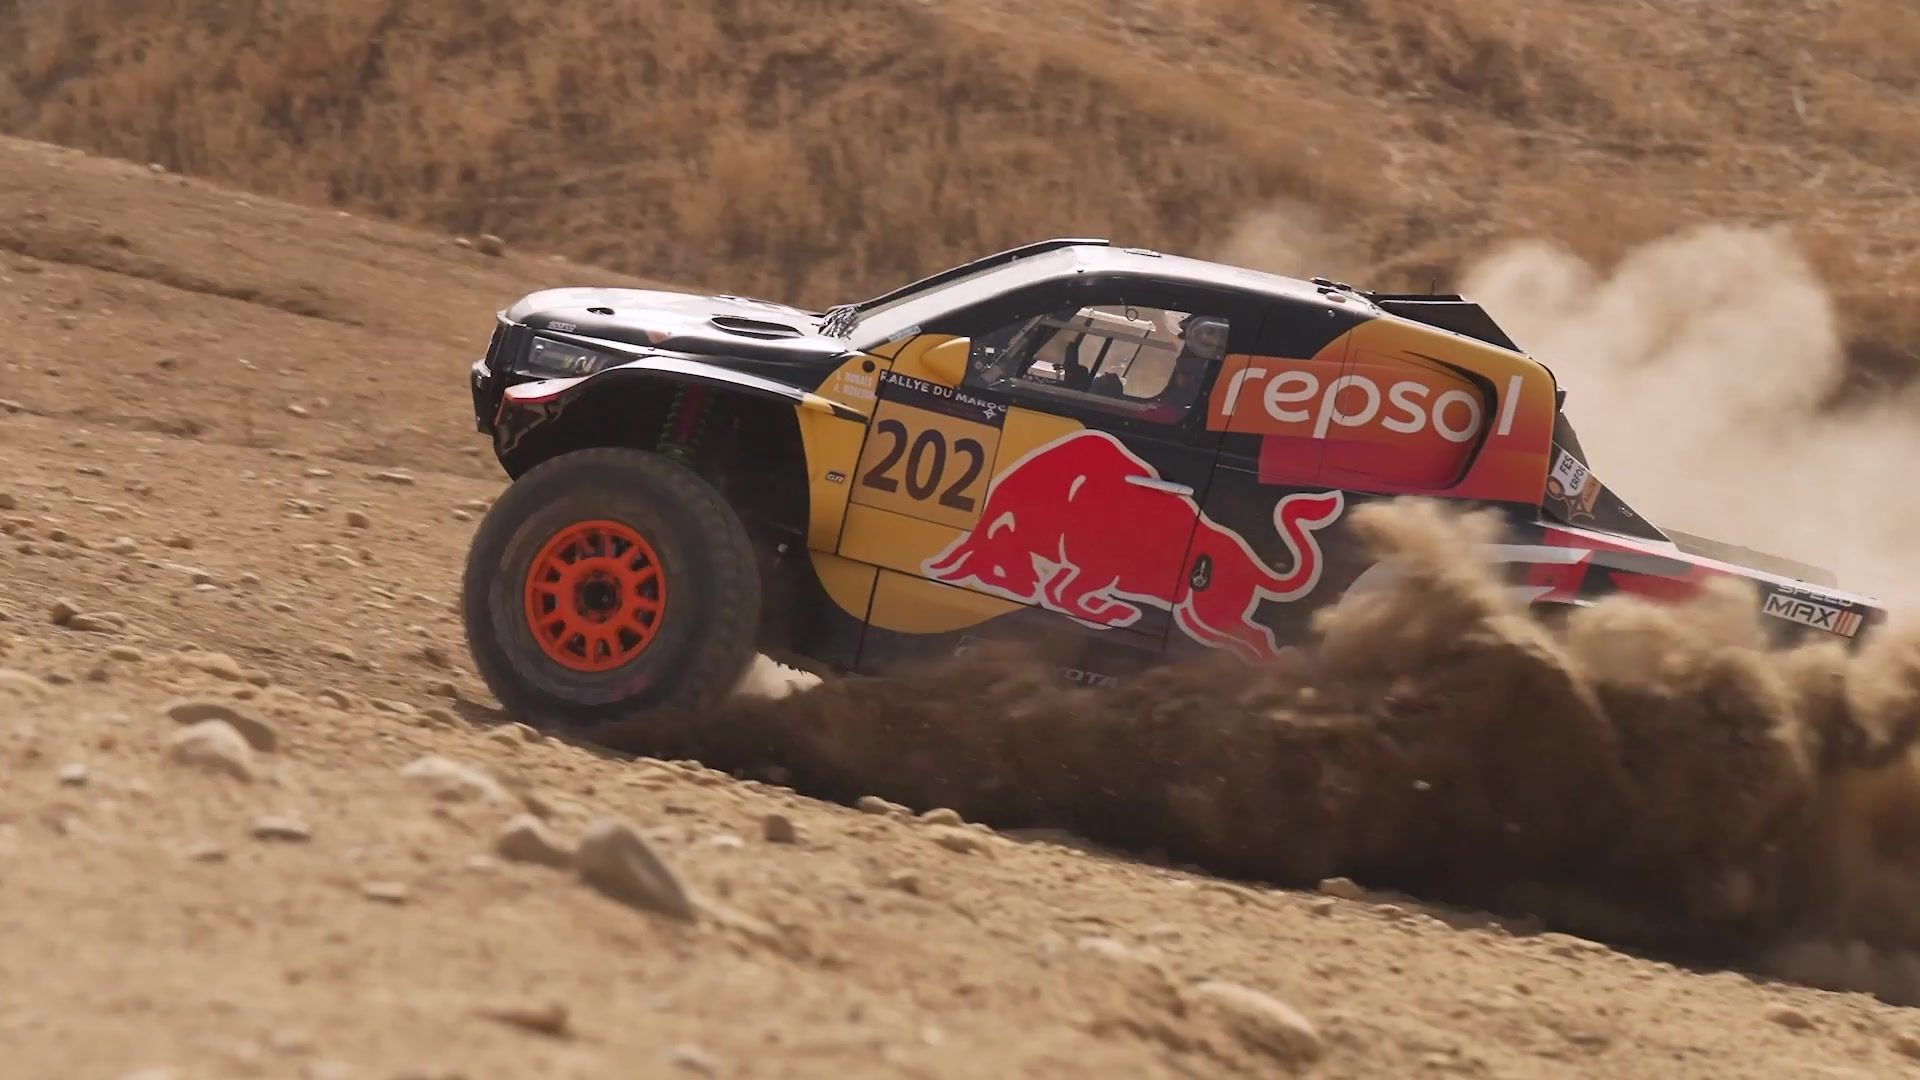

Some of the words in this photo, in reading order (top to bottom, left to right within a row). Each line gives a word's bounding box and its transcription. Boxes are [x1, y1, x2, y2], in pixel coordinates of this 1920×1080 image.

[880, 371, 928, 393] RALLYE
[933, 387, 953, 398] DU
[955, 393, 1006, 412] MAROC
[1222, 367, 1523, 442] repsol
[862, 419, 984, 513] 202
[1767, 597, 1836, 627] MAX
[1777, 585, 1853, 607] SPEED
